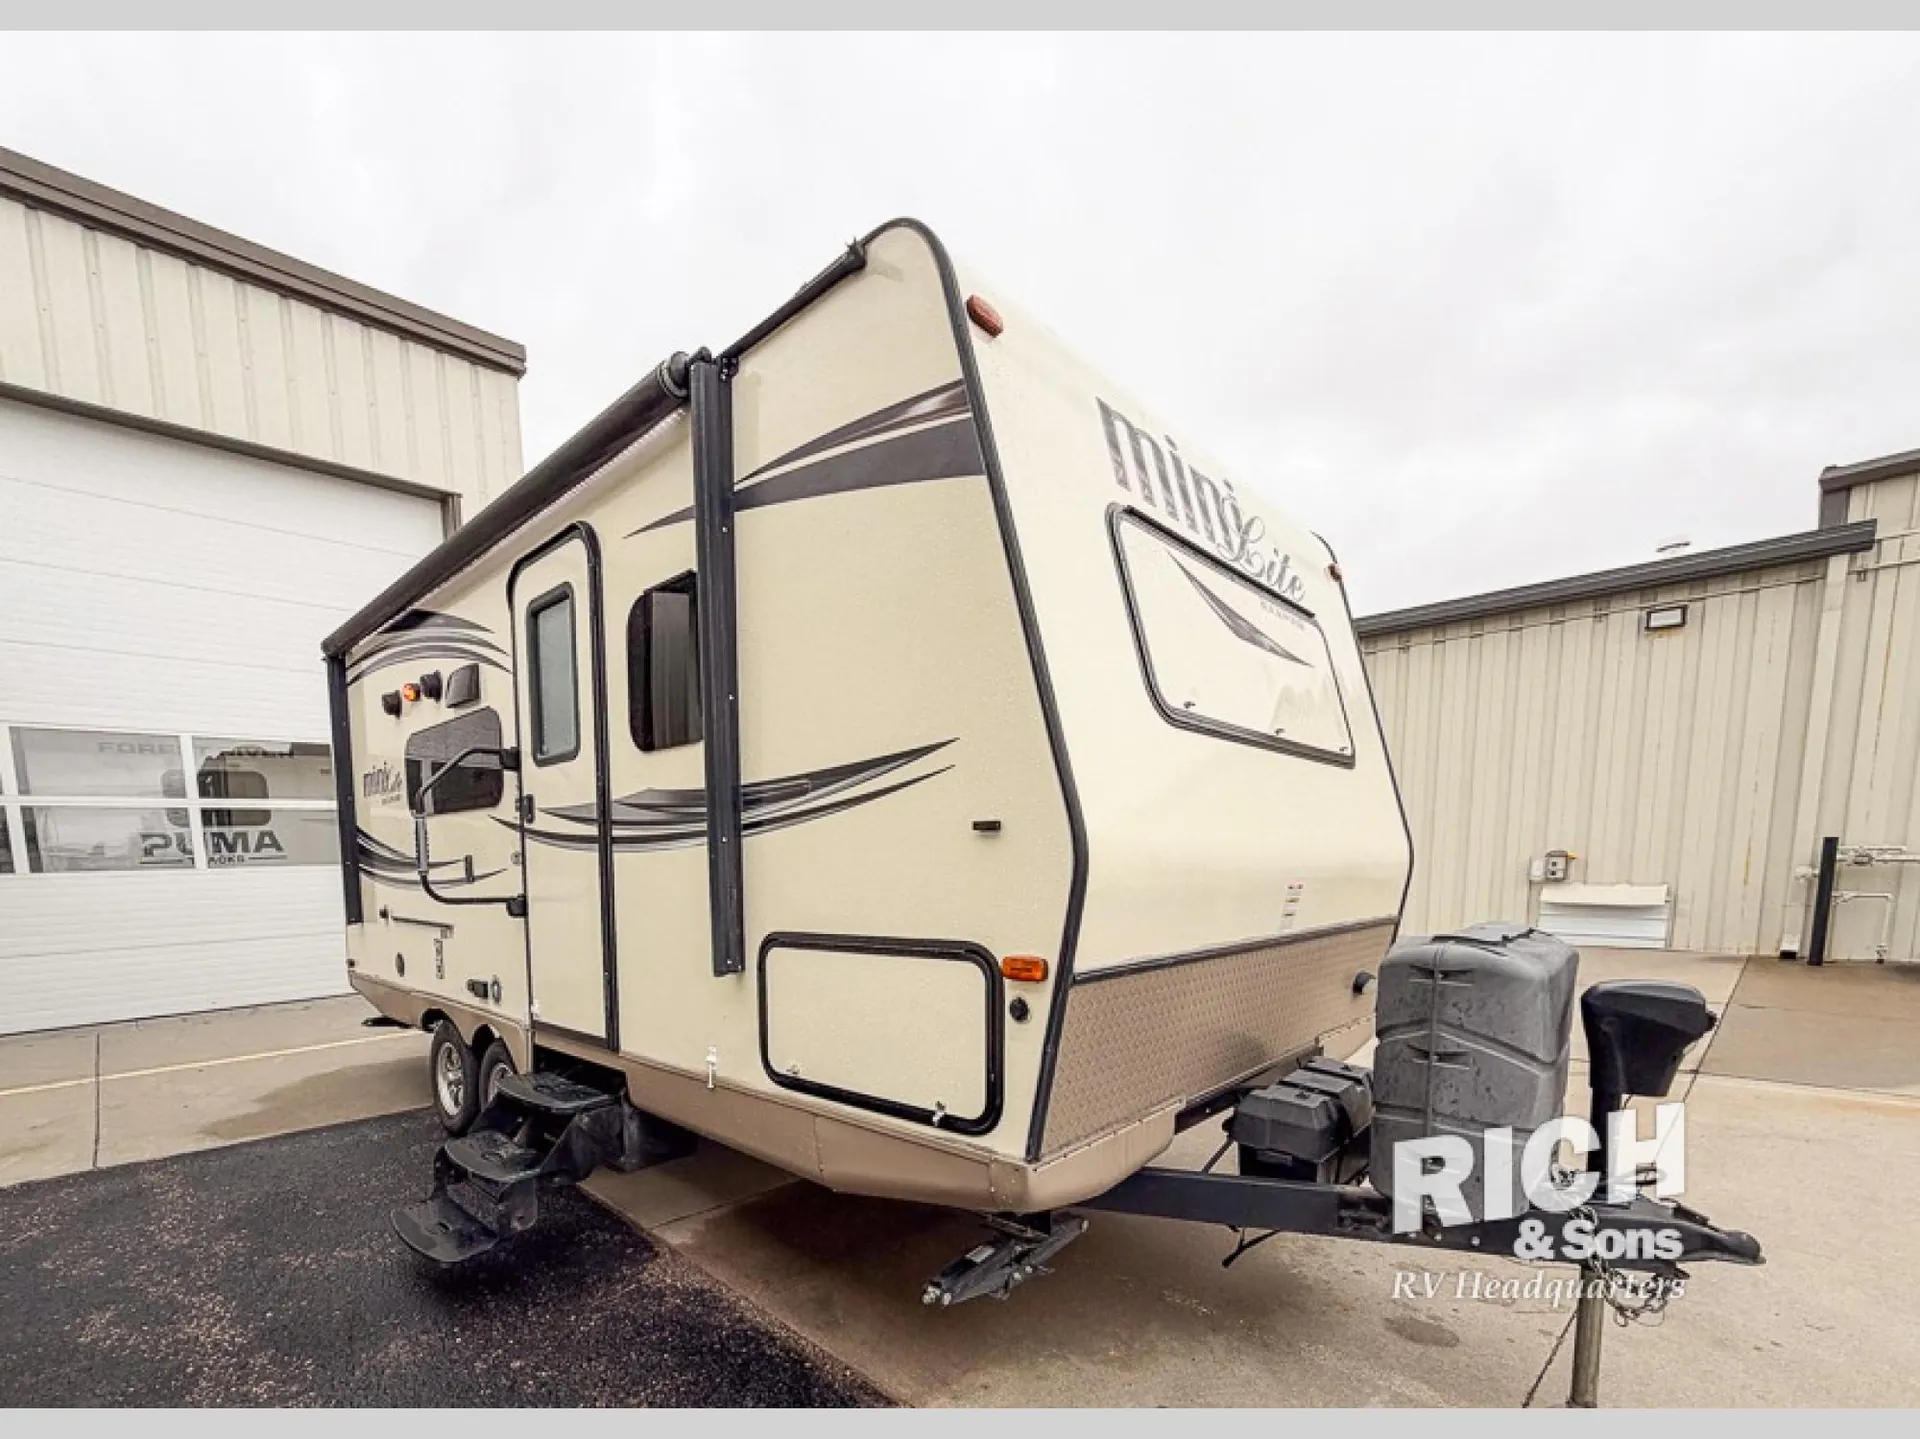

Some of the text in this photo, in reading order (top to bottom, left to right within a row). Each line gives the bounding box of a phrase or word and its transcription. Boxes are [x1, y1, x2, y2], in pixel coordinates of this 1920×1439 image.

[1095, 396, 1306, 602] mini Lite
[97, 742, 210, 756] FORET
[140, 829, 284, 857] PUMA
